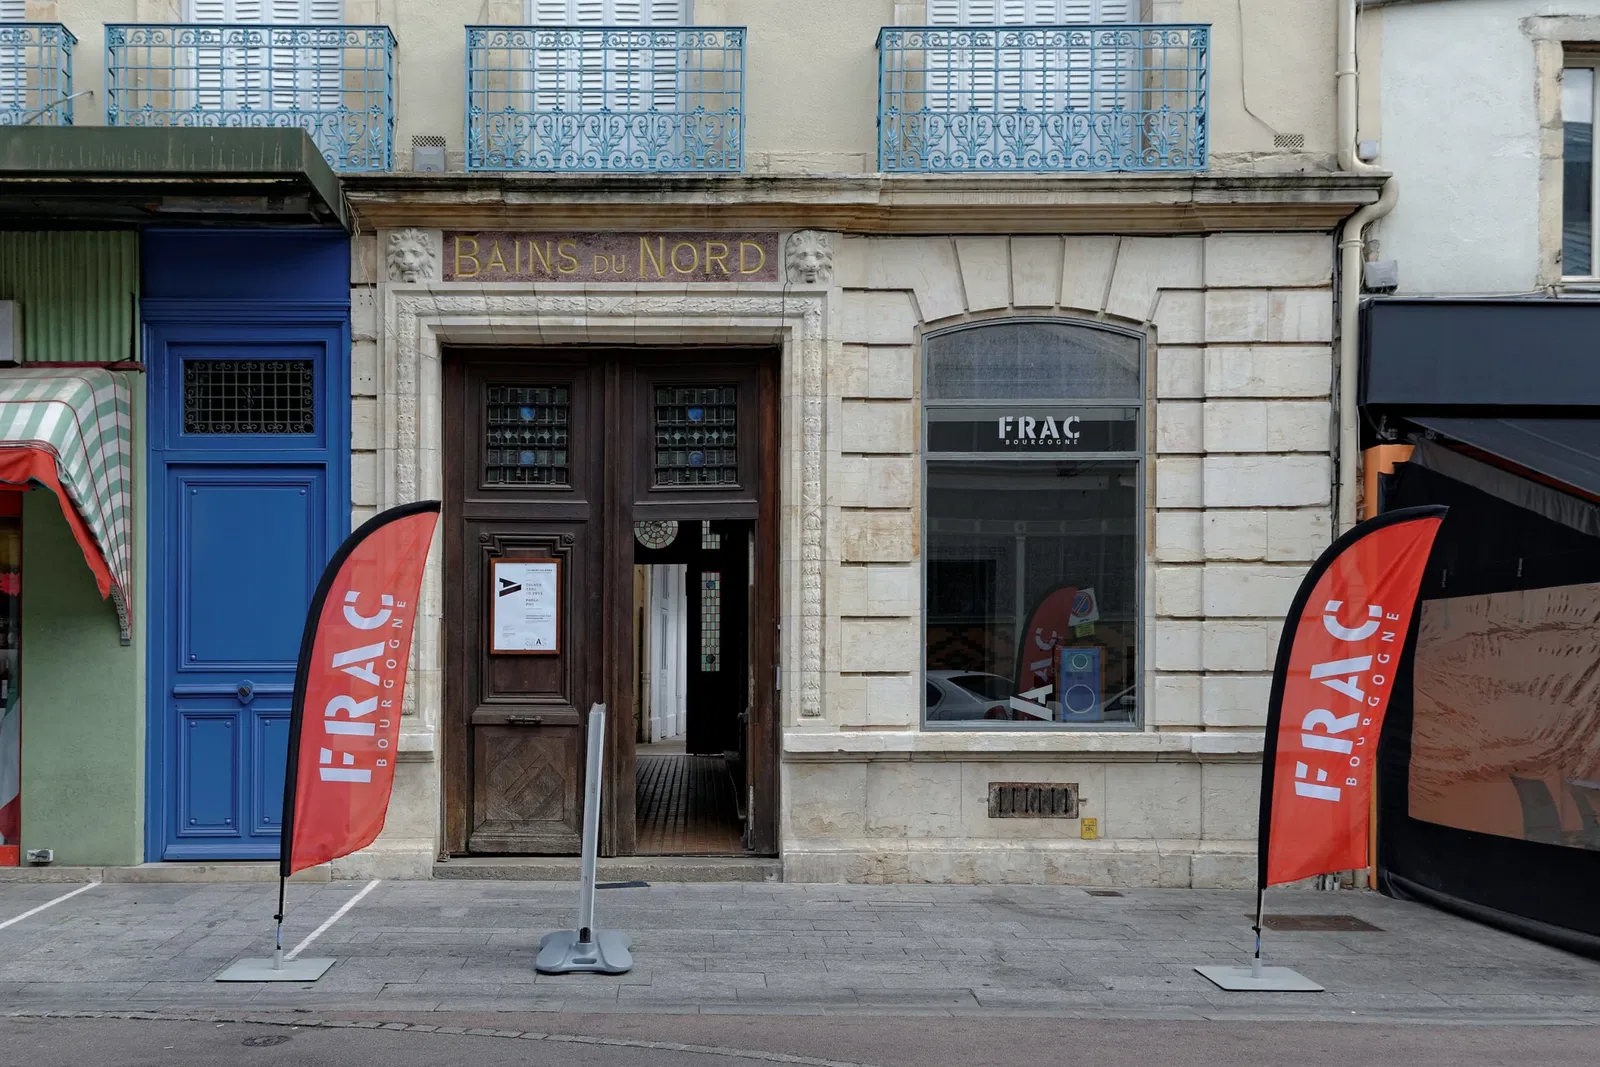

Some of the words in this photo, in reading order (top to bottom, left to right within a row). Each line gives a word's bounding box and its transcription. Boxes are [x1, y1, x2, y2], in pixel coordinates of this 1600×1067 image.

[453, 235, 579, 278] BAINS
[593, 253, 627, 274] DU
[639, 236, 766, 279] NORD
[998, 416, 1080, 439] FRAC
[319, 590, 394, 783] FRAC
[376, 600, 407, 767] BOURGOGNE
[1294, 599, 1383, 802] FRAC
[1345, 612, 1400, 786] BOURGOGNE
